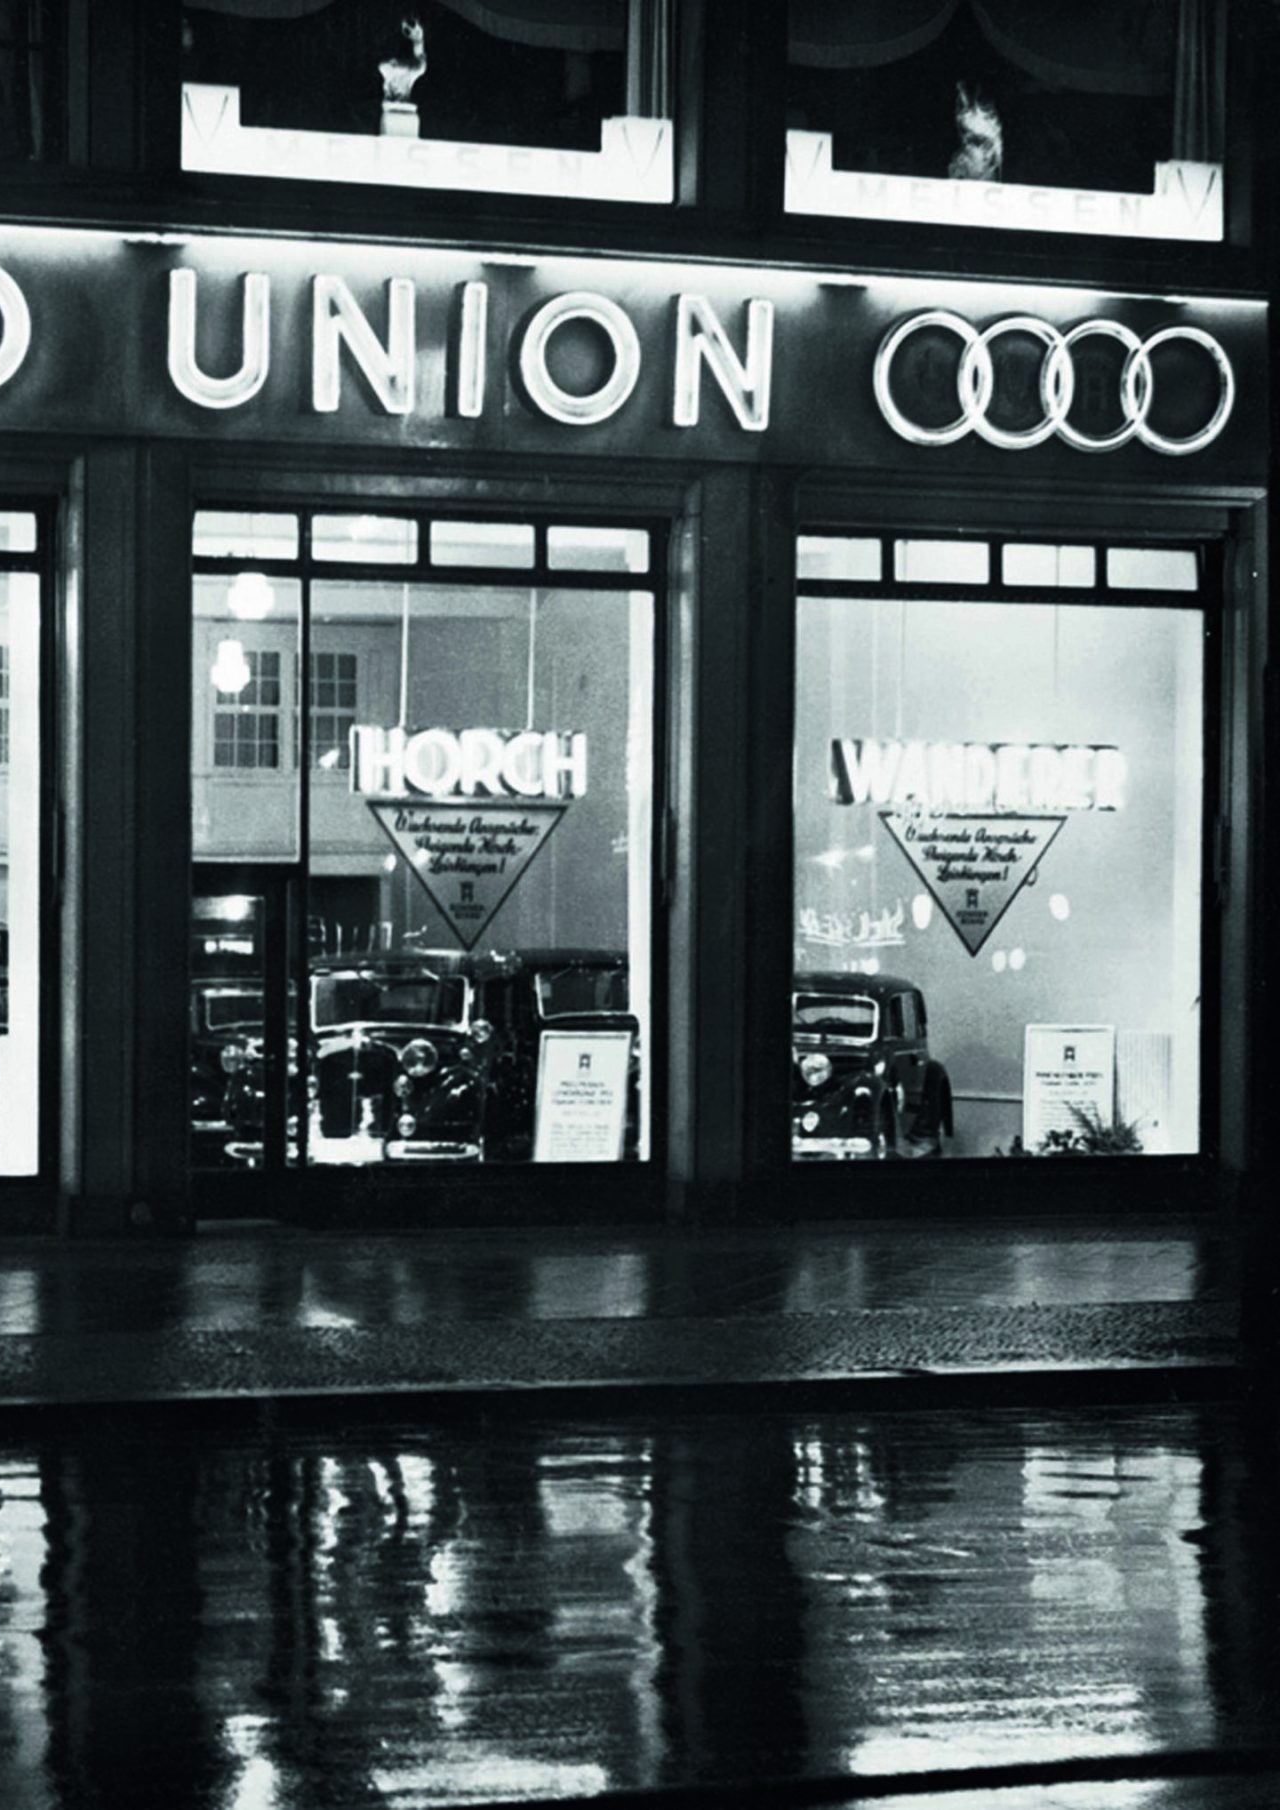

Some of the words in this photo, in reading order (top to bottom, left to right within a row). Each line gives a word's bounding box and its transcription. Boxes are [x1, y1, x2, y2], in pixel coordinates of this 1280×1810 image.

[265, 133, 585, 187] MEISSEN
[855, 176, 1142, 229] MEISSEN
[168, 267, 773, 431] UNION
[355, 727, 587, 798] HORCH
